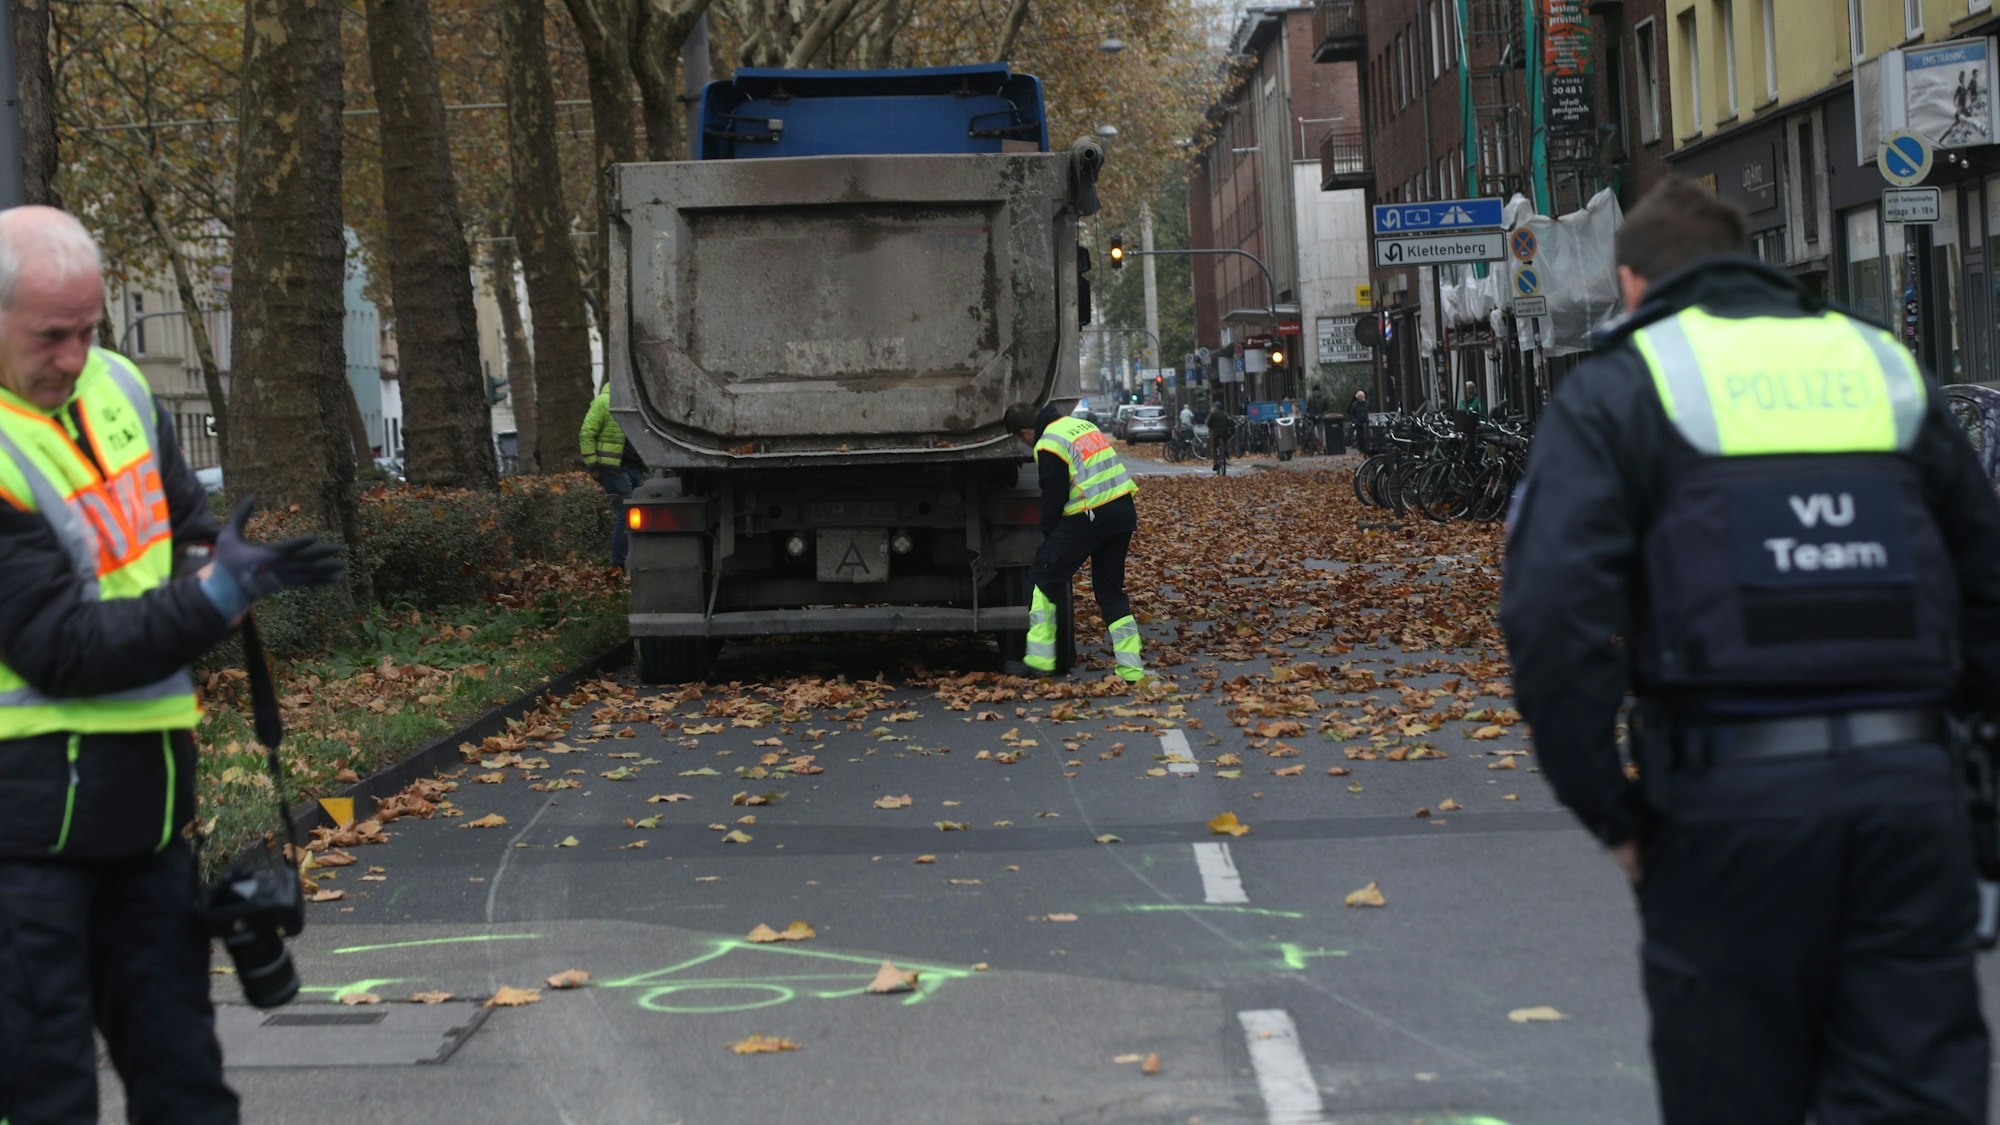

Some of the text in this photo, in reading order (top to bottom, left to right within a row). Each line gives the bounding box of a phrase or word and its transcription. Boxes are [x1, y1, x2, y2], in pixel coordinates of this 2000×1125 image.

[1922, 49, 1967, 66] EMS TRAINING
[1414, 213, 1421, 222] 4
[1407, 242, 1486, 258] Klettenberg
[1788, 492, 1856, 528] VU
[834, 541, 871, 574] A
[1763, 537, 1888, 572] Team
